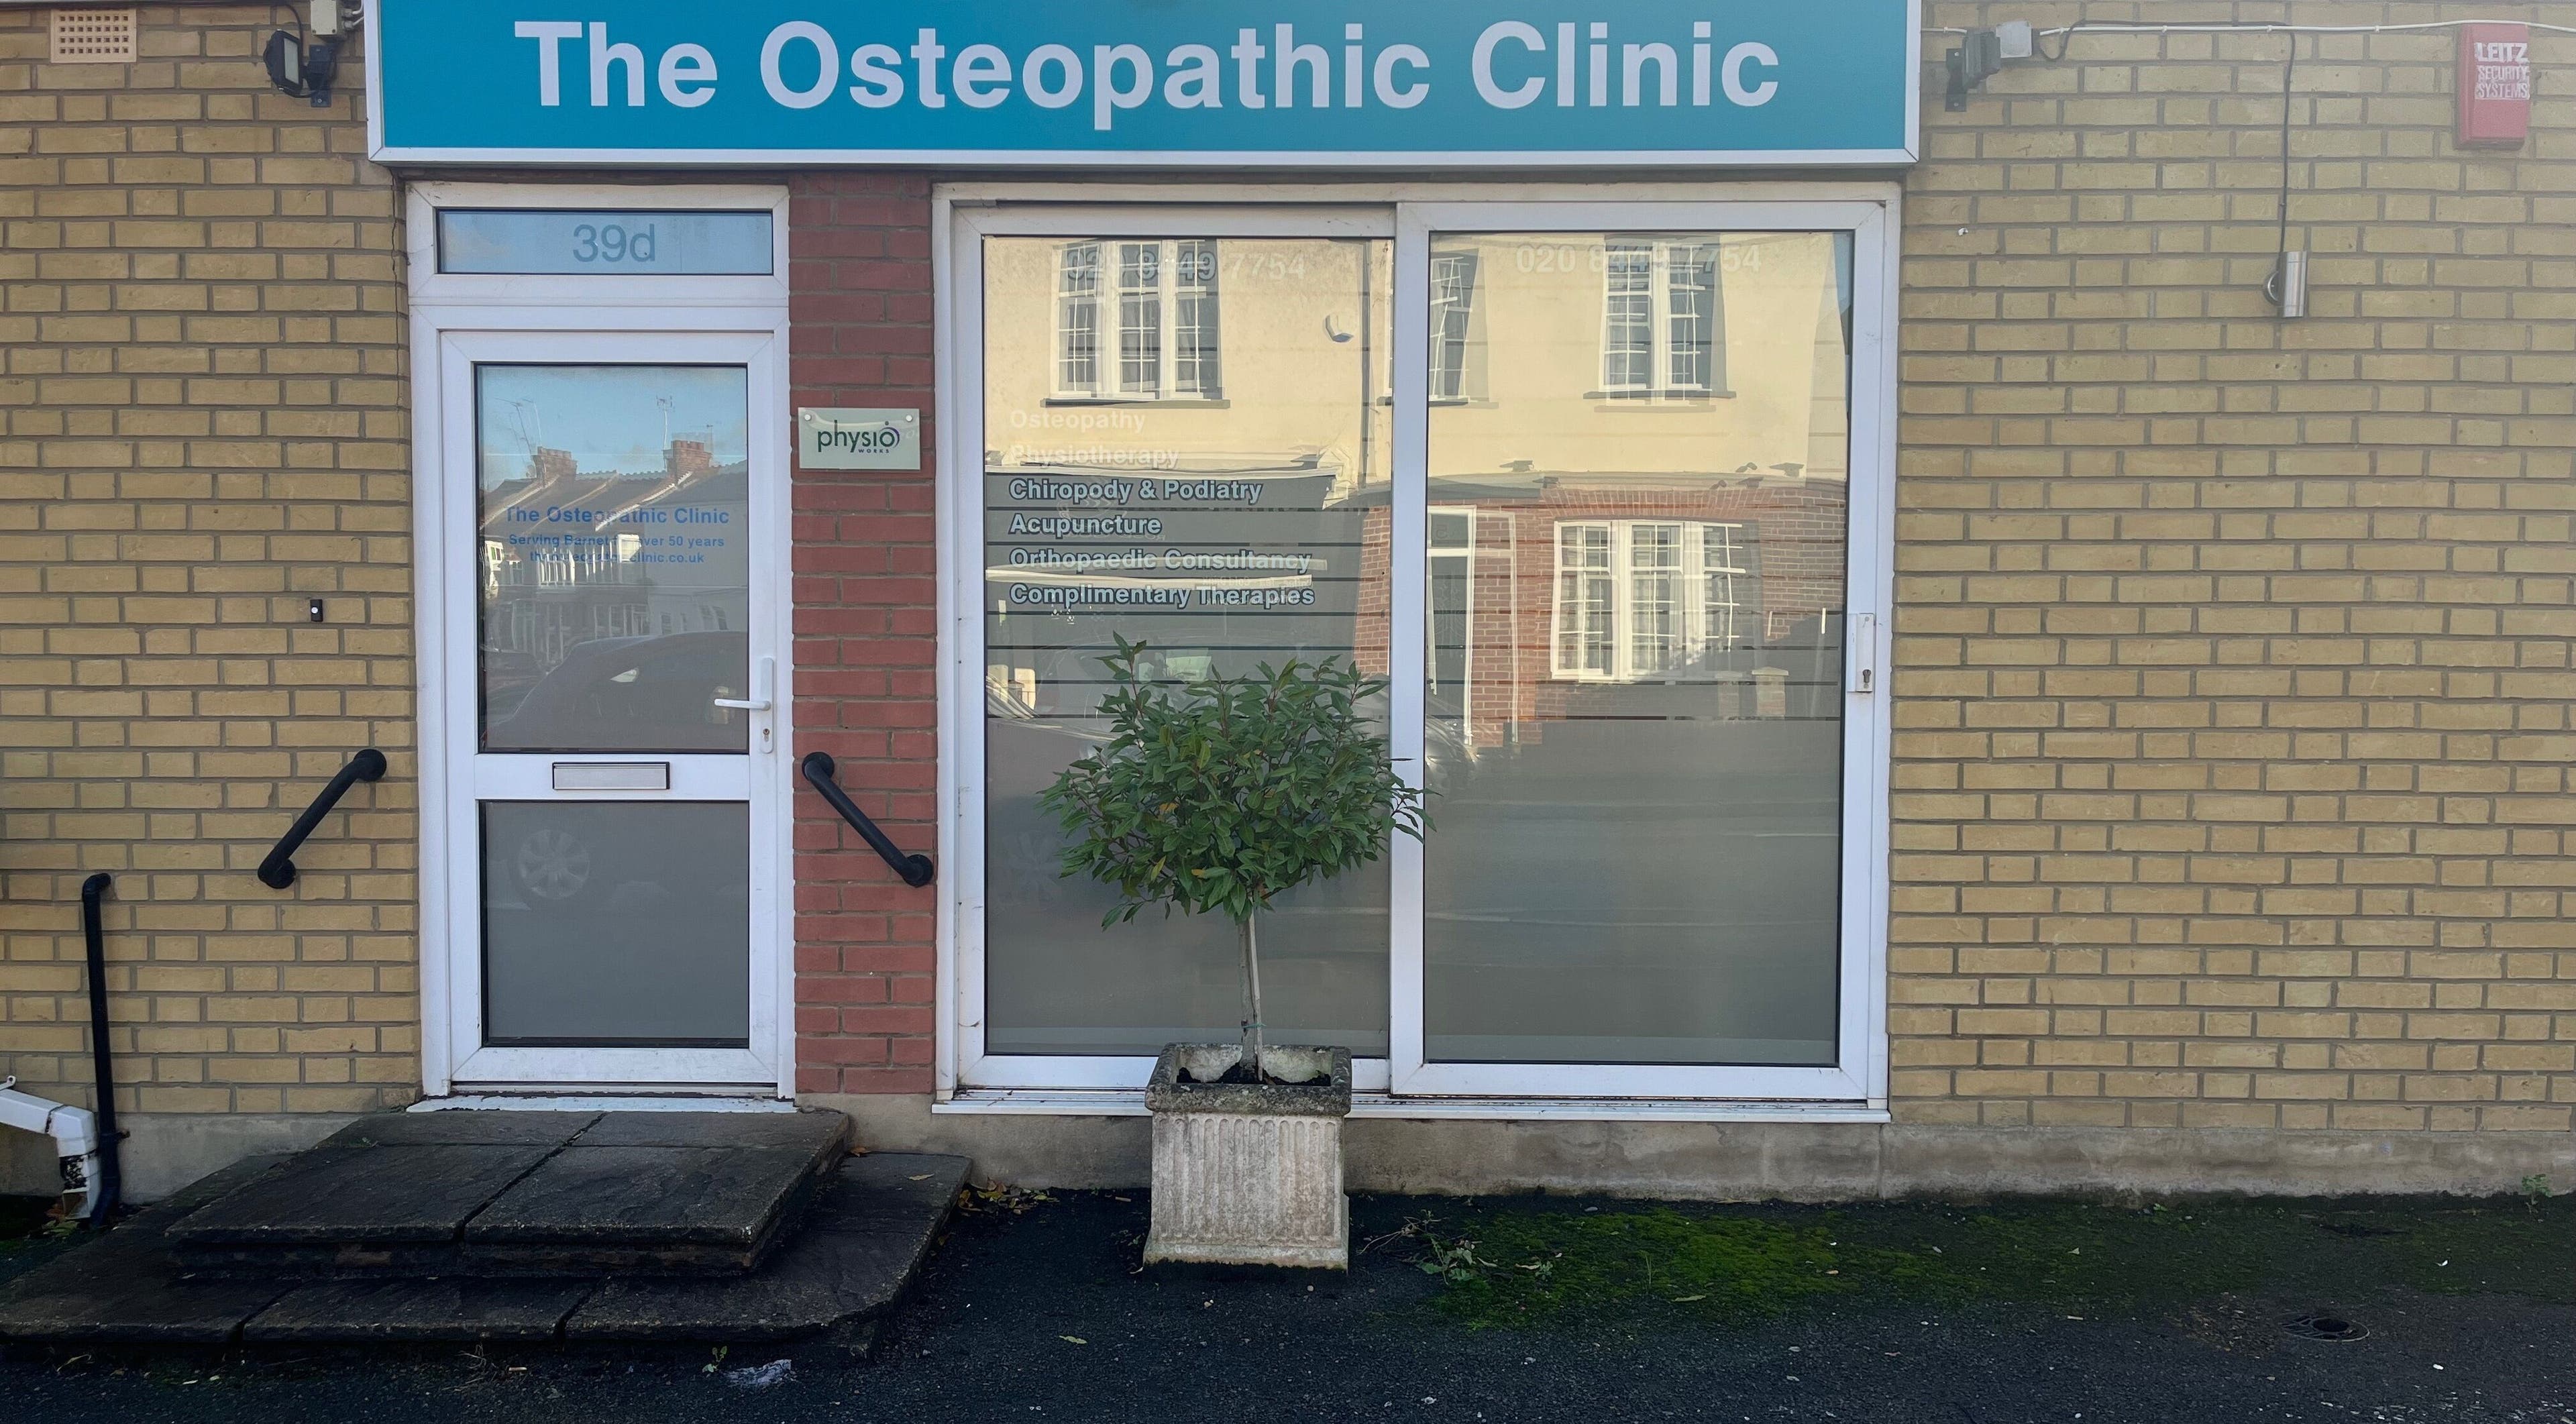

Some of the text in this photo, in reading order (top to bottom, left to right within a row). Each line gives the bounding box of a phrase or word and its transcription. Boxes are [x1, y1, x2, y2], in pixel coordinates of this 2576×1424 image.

[2474, 42, 2530, 62] LEITZ
[515, 20, 1780, 130] The Osteopathic Clinic
[2477, 66, 2529, 81] SECURITY
[2477, 83, 2529, 99] SYSTEMS
[573, 223, 655, 262] 39d
[1136, 251, 1216, 281] 849
[1516, 243, 1576, 274] 020
[1010, 410, 1145, 433] Osteopathy
[817, 420, 900, 452] physio
[1010, 445, 1179, 470] Physiotherapy
[1009, 478, 1263, 505] Chiropody & Podiatry
[507, 506, 539, 522] The
[674, 507, 730, 524] Clinic
[1008, 513, 1162, 539] Acupuncture
[509, 534, 559, 547] Serving
[564, 535, 609, 545] Barnet
[669, 536, 683, 546] 50
[685, 537, 724, 548] years
[1009, 547, 1312, 575] Orthopaedic Consultancy
[1009, 584, 1316, 610] Complimentary Therapies
